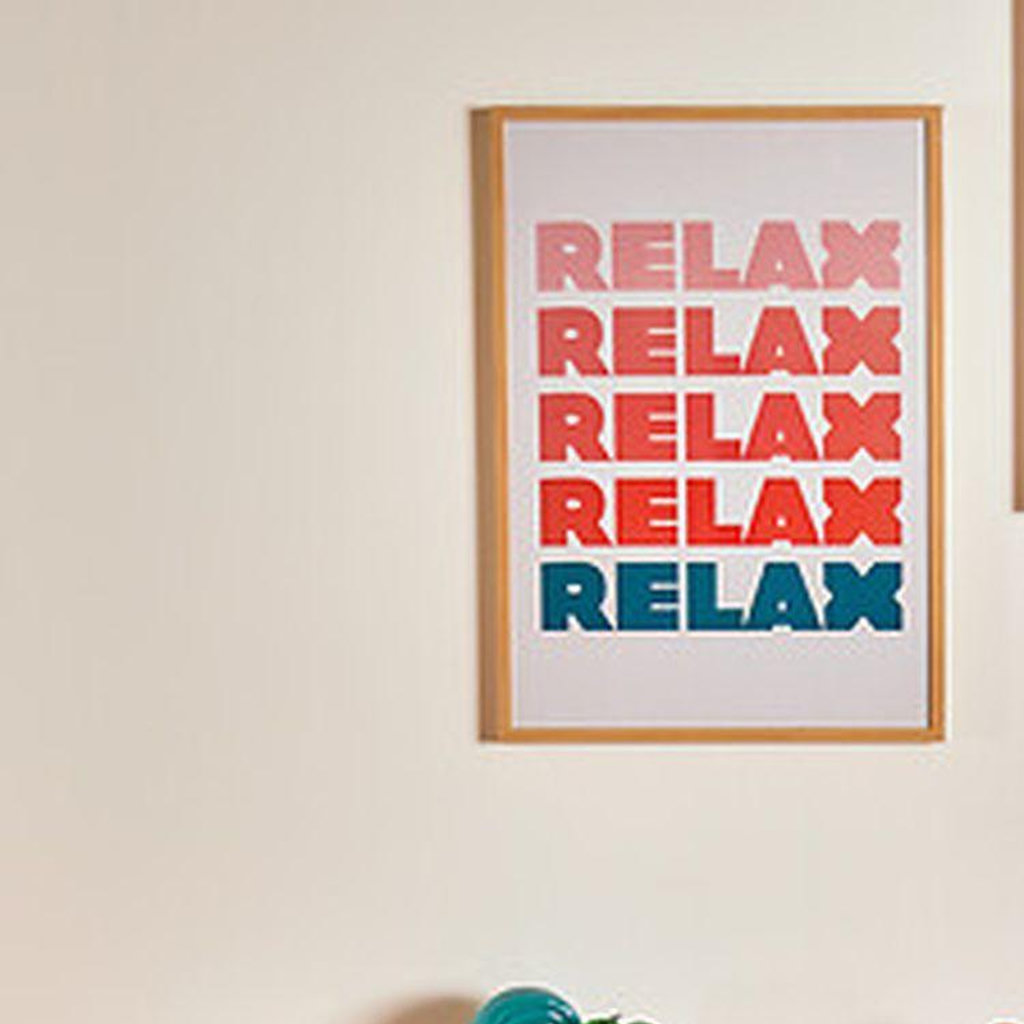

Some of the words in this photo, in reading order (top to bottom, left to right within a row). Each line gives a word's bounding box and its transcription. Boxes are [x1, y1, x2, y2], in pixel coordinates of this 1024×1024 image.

[536, 221, 901, 291] RELAX
[537, 306, 902, 377] RELAX
[538, 392, 902, 463] RELAX
[539, 476, 903, 548] RELAX
[540, 562, 903, 632] RELAX
